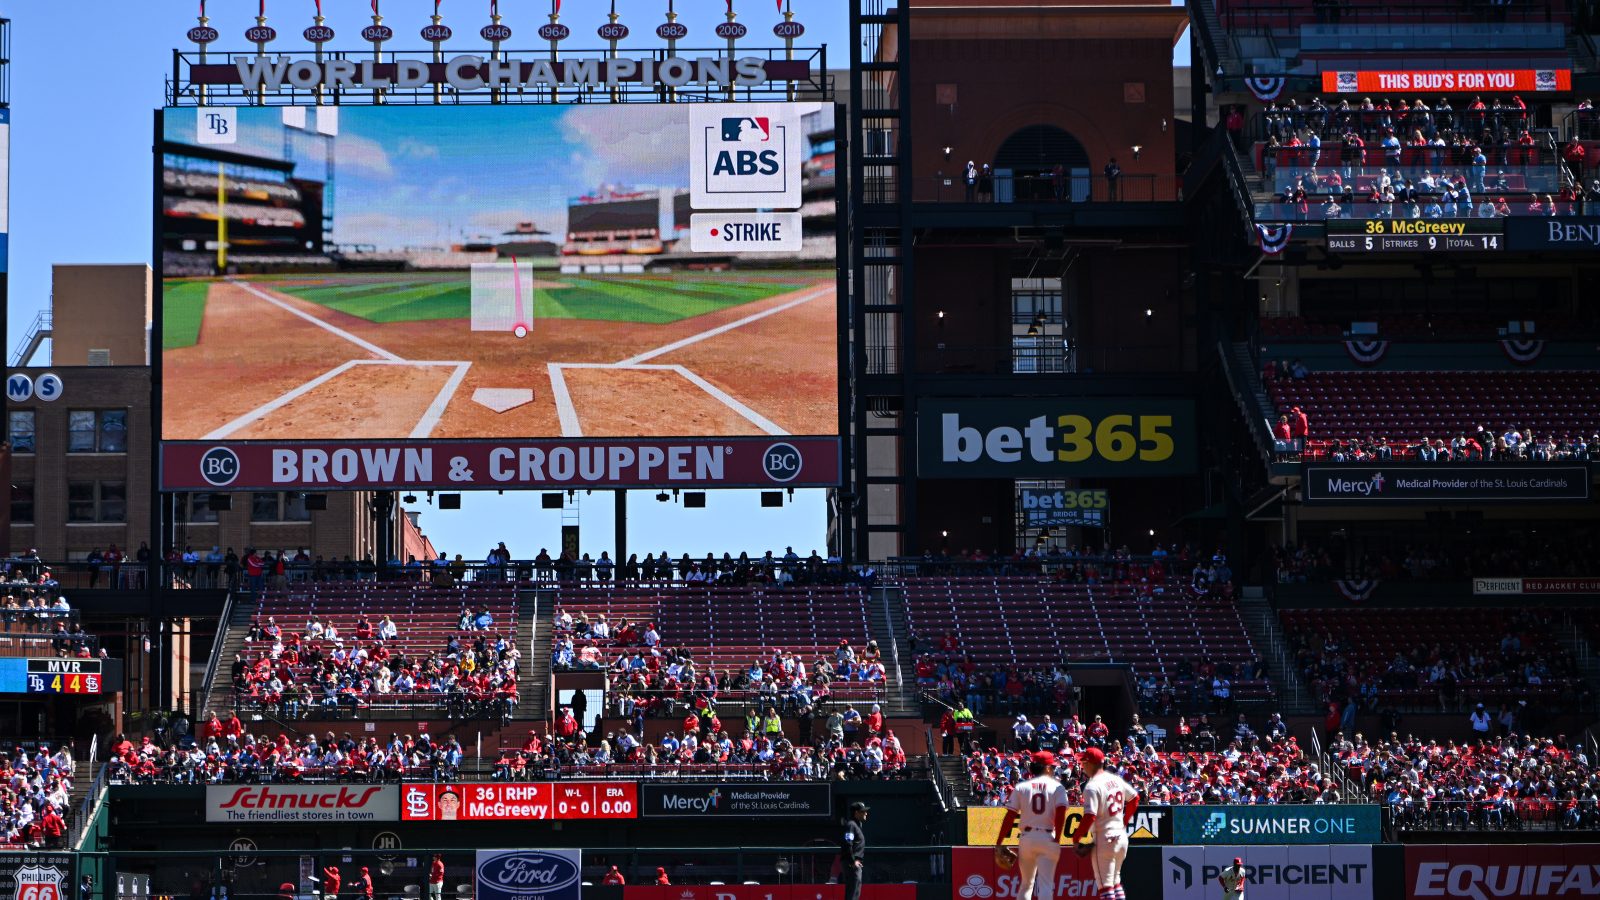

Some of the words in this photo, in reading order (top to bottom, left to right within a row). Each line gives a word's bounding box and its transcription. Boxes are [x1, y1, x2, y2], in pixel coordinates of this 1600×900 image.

[190, 29, 215, 40] 1926
[249, 28, 272, 39] 1931
[307, 28, 331, 39] 1934
[364, 28, 388, 39] 1942
[424, 28, 448, 39] 1944
[482, 26, 509, 38] 1946
[541, 27, 566, 37] 1964
[600, 26, 626, 37] 1967
[660, 26, 684, 36] 1982
[719, 25, 744, 36] 2006
[777, 25, 801, 35] 2011
[234, 56, 430, 91] WORLD
[445, 55, 768, 90] CHAMPIONS
[1378, 74, 1410, 88] THIS
[1413, 73, 1454, 88] BUD'S
[1458, 73, 1487, 88] FOR
[1487, 73, 1515, 87] YOU
[713, 149, 779, 175] ABS
[723, 223, 781, 241] STRIKE
[1366, 221, 1384, 233] 36
[1392, 221, 1466, 235] McGreevy
[1329, 240, 1355, 248] BALLS
[1364, 237, 1374, 250] 5
[1385, 240, 1418, 248] STRIKES
[1428, 236, 1437, 249] 9
[1450, 239, 1475, 247] TOTAL
[1481, 236, 1498, 249] 14
[942, 413, 1174, 462] bet365
[207, 457, 233, 475] BC
[272, 447, 433, 483] BROWN
[448, 456, 474, 481] &
[769, 454, 796, 471] BC
[1328, 478, 1374, 495] Mercy
[1396, 479, 1431, 488] Medical
[1433, 479, 1468, 488] Provider
[1470, 479, 1479, 488] of
[1480, 479, 1493, 488] the
[1495, 478, 1504, 488] St.
[1506, 478, 1528, 488] Louis
[1529, 478, 1567, 488] Cardinals
[1022, 490, 1107, 509] bet365
[1526, 582, 1542, 590] RED
[1545, 582, 1578, 590] JACKET
[48, 661, 81, 673] MVR
[51, 675, 61, 692] 4
[70, 675, 81, 692] 4
[476, 787, 495, 801] 36
[505, 787, 537, 800] RHP
[565, 788, 582, 797] W-L
[606, 788, 624, 797] ERA
[731, 792, 760, 800] Medical
[761, 792, 790, 800] Provider
[558, 802, 568, 814] 0
[580, 801, 590, 814] 0
[601, 801, 632, 814] 0.00
[663, 794, 710, 813] Mercy
[731, 801, 739, 809] of
[739, 801, 750, 809] the
[760, 801, 778, 809] Louis
[778, 801, 810, 809] Cardinals
[1031, 792, 1046, 815] 0
[226, 810, 246, 820] The
[247, 809, 300, 820] friendliest
[302, 811, 333, 820] stores
[335, 810, 345, 820] in
[347, 811, 374, 820] town
[469, 802, 548, 819] McGreevy
[378, 837, 395, 849] JH
[21, 873, 57, 881] PHILLIPS
[498, 857, 559, 884] Ford
[1203, 863, 1367, 885] PRFICIENT
[23, 886, 54, 900] 66
